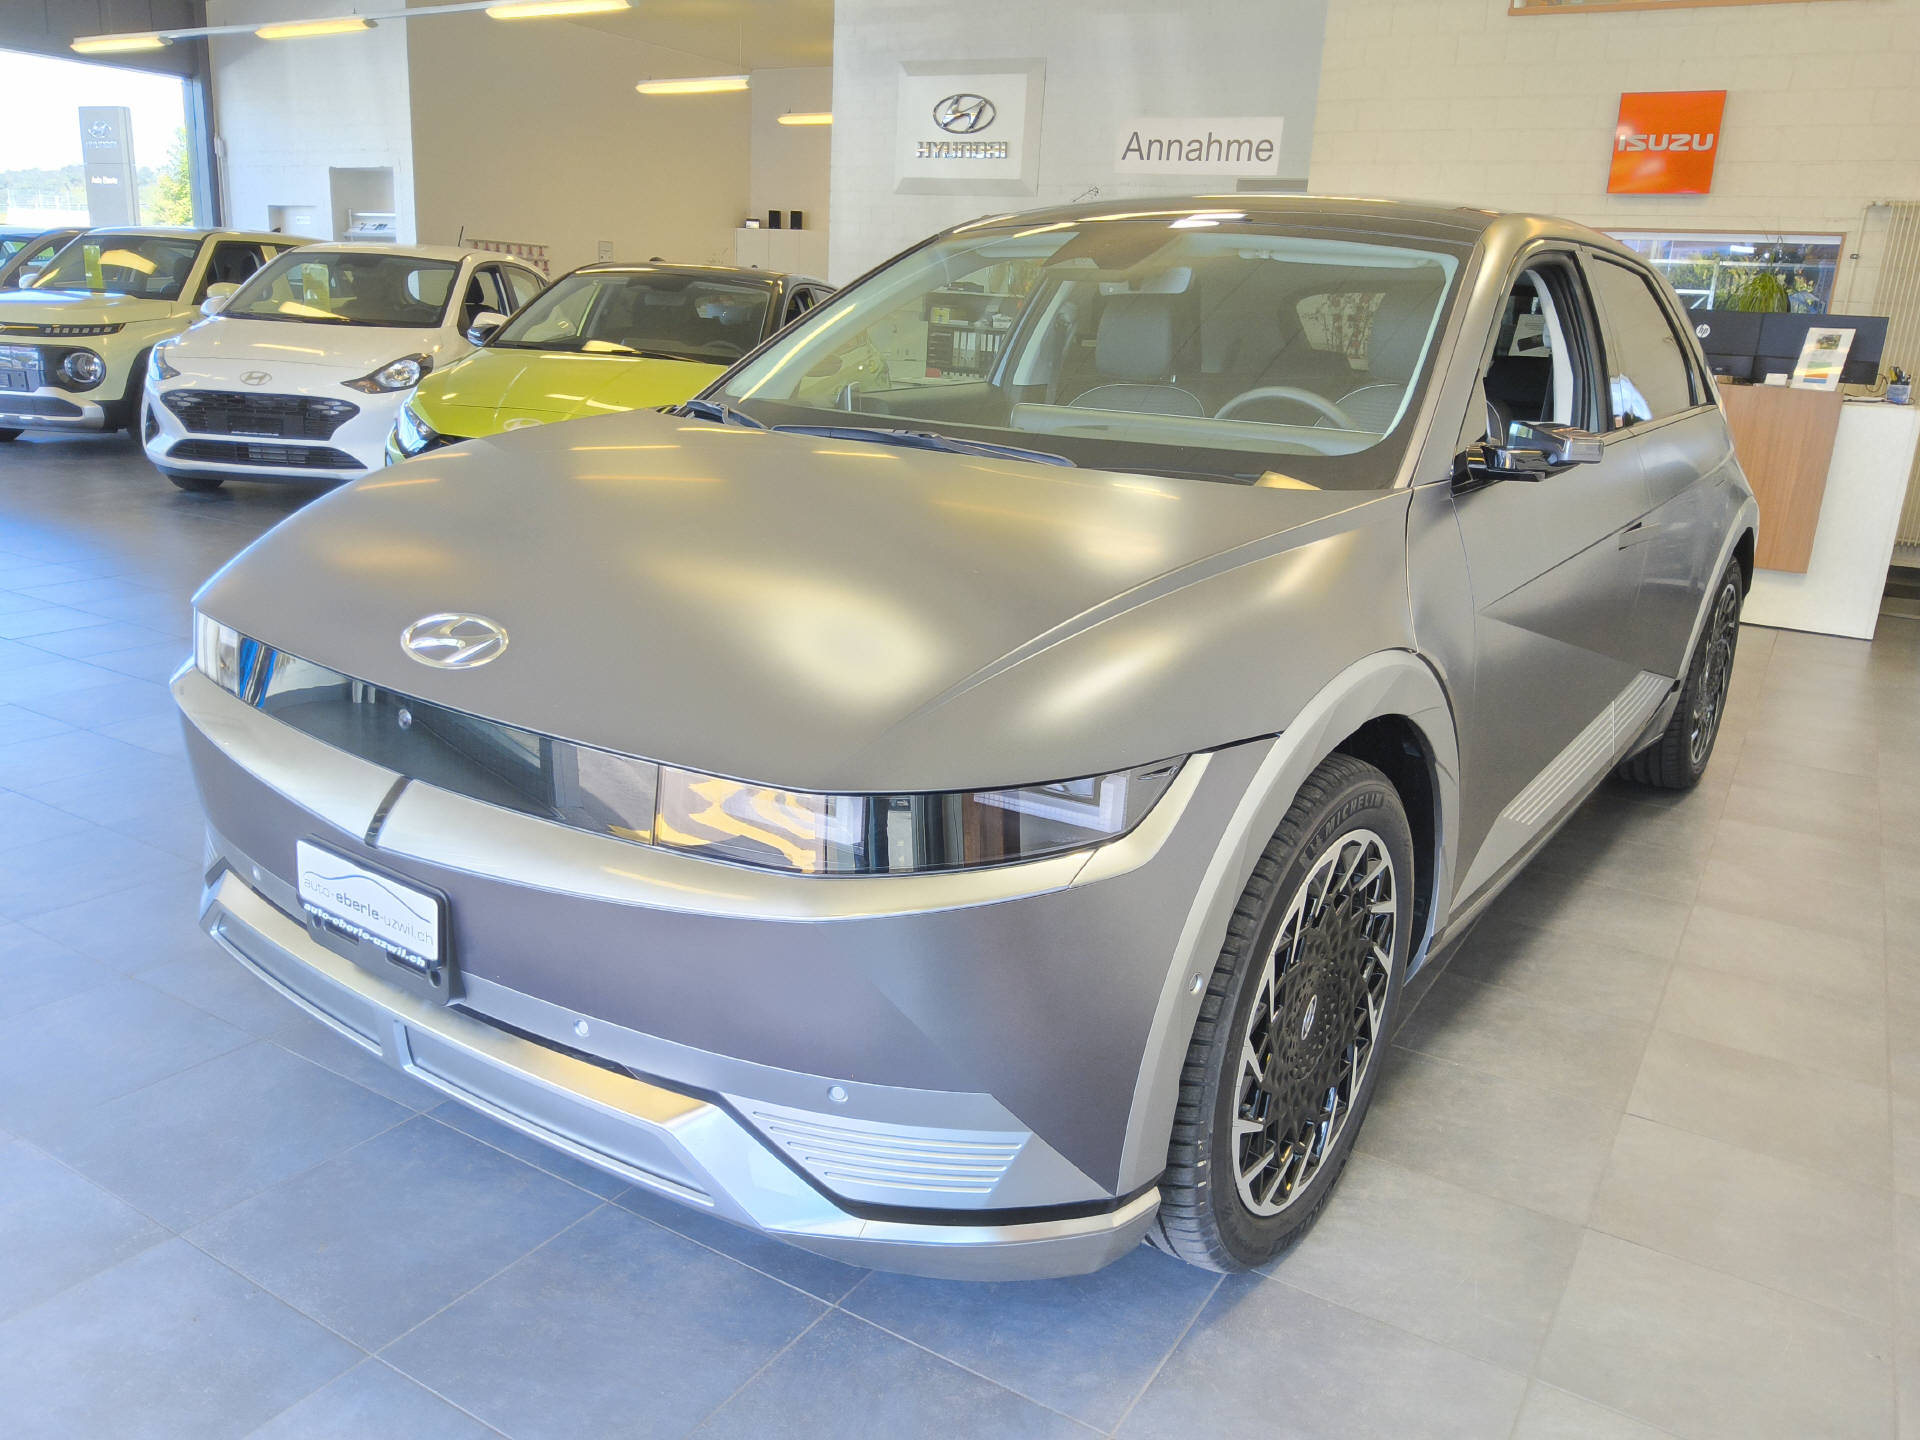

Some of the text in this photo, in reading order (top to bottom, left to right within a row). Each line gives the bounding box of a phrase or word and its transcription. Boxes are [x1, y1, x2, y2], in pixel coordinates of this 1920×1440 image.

[916, 141, 1008, 159] HYUNDAI
[1121, 131, 1274, 162] Annahme
[1618, 133, 1714, 152] ISUZU
[1696, 324, 1710, 338] hp
[1325, 792, 1384, 837] MICHELIN
